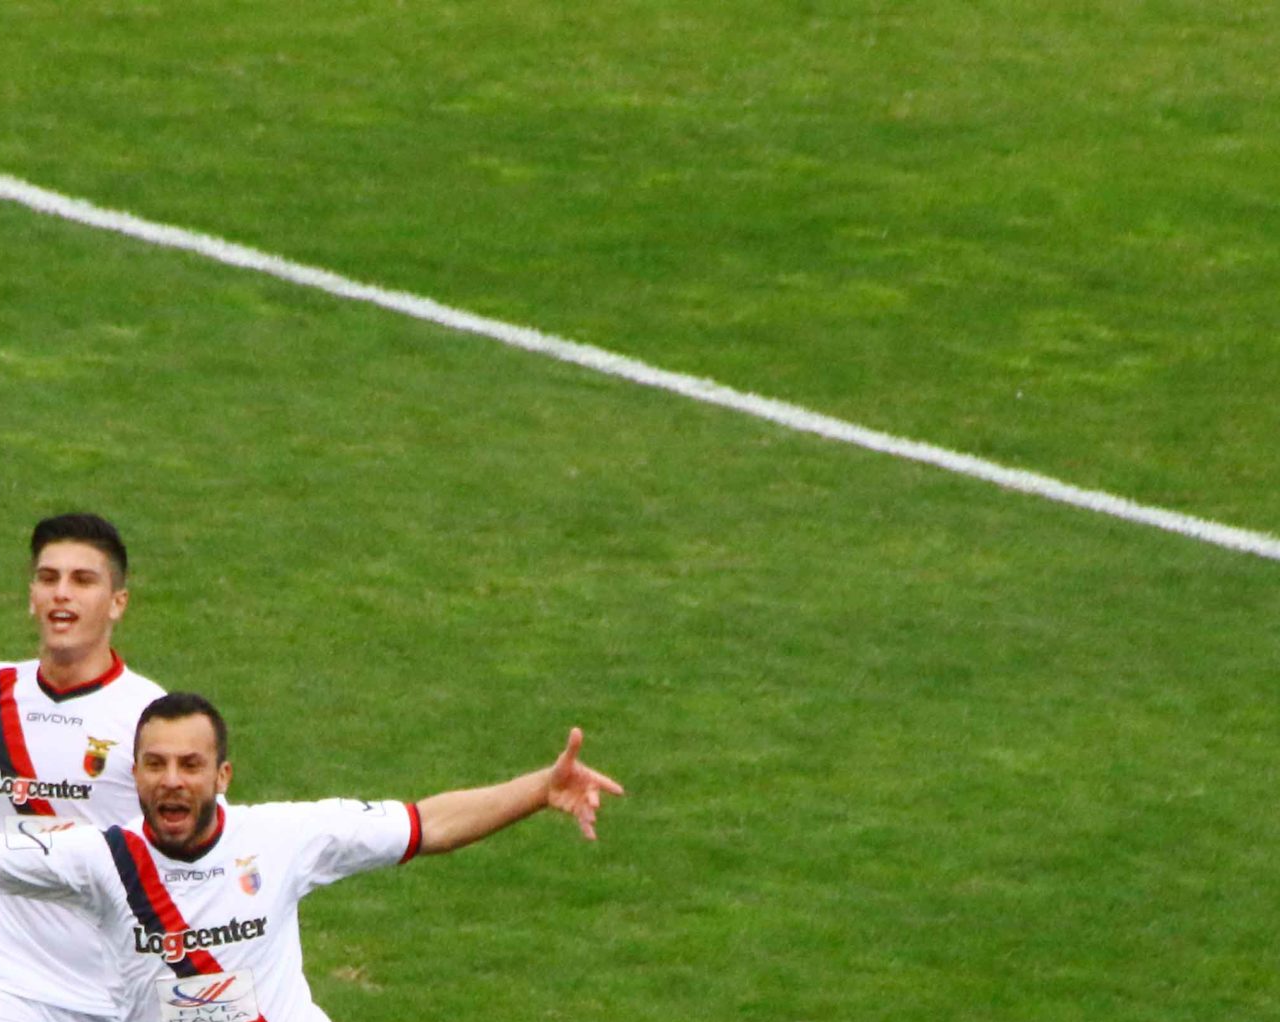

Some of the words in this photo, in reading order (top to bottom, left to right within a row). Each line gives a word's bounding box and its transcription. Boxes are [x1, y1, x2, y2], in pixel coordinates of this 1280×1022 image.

[26, 712, 84, 726] GIVOVA
[164, 867, 225, 882] GIVOVA
[133, 916, 267, 962] Logcenter
[179, 1004, 237, 1017] FIVE
